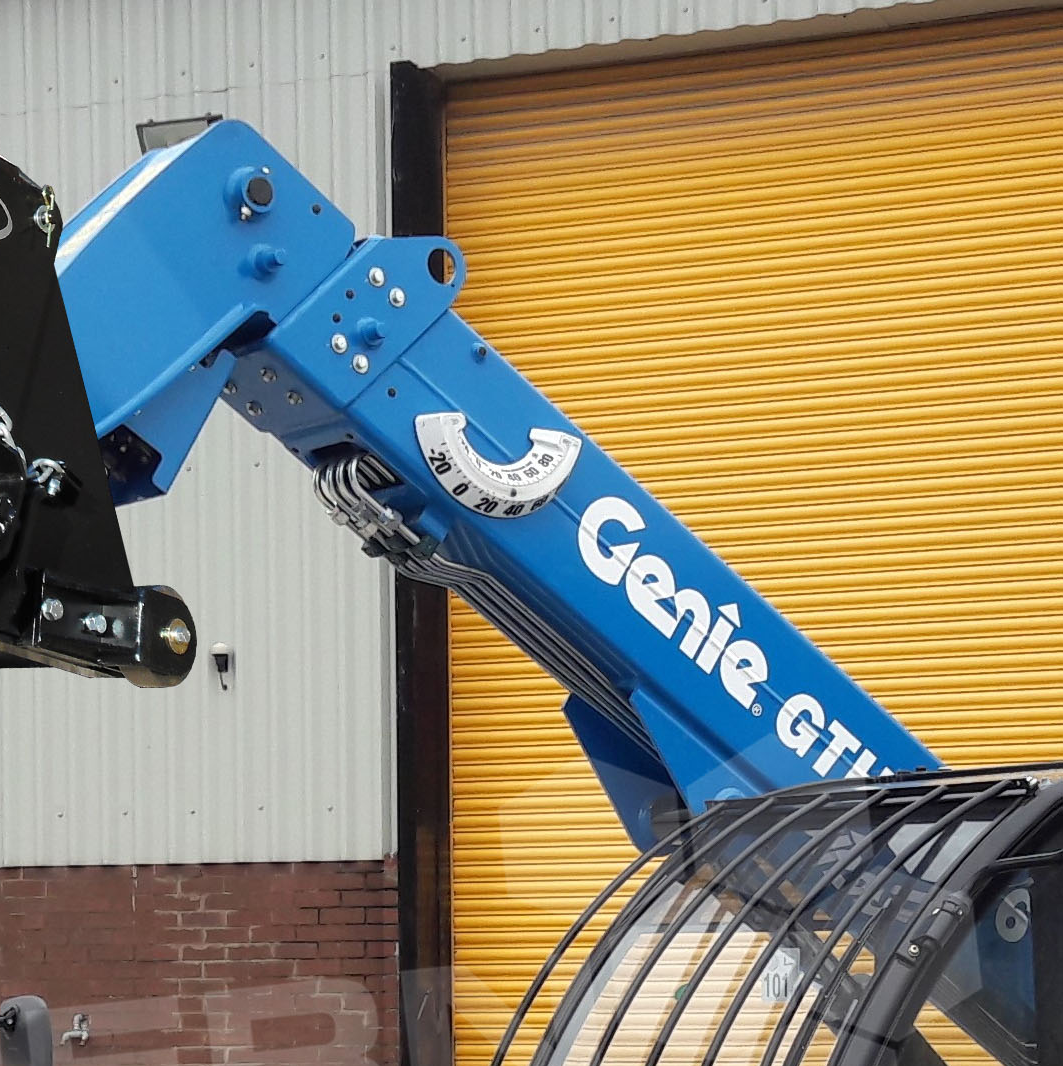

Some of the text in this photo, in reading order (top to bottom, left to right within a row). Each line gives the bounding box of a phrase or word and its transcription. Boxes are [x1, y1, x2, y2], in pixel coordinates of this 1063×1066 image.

[523, 466, 540, 478] 60
[538, 453, 554, 467] 80
[452, 483, 469, 498] 0
[473, 497, 499, 513] 20
[503, 504, 525, 516] 40
[577, 496, 769, 710] Genie
